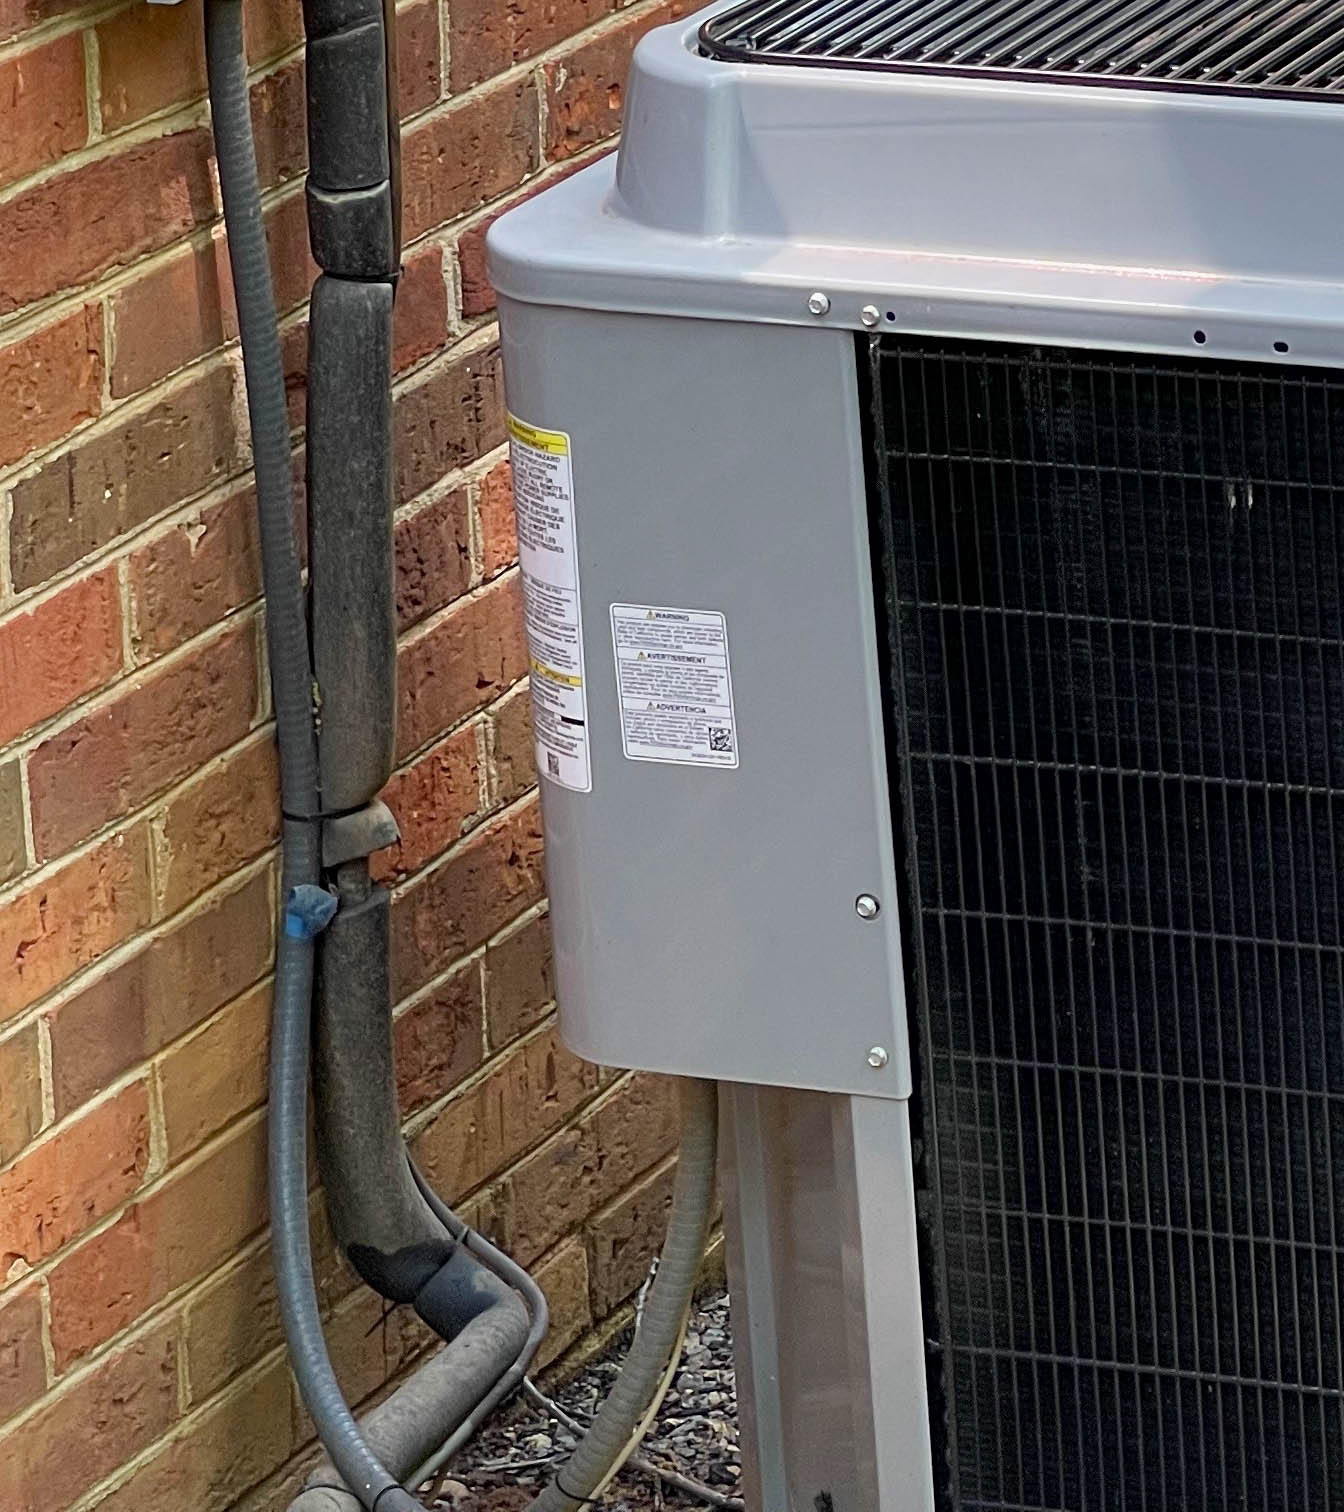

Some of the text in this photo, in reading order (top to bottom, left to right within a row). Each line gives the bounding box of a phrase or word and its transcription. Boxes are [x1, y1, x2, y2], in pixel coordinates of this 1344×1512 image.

[655, 612, 690, 622] WARNING
[647, 652, 707, 665] AVERTISSEMENT
[656, 703, 707, 715] ADVERTENCIA
